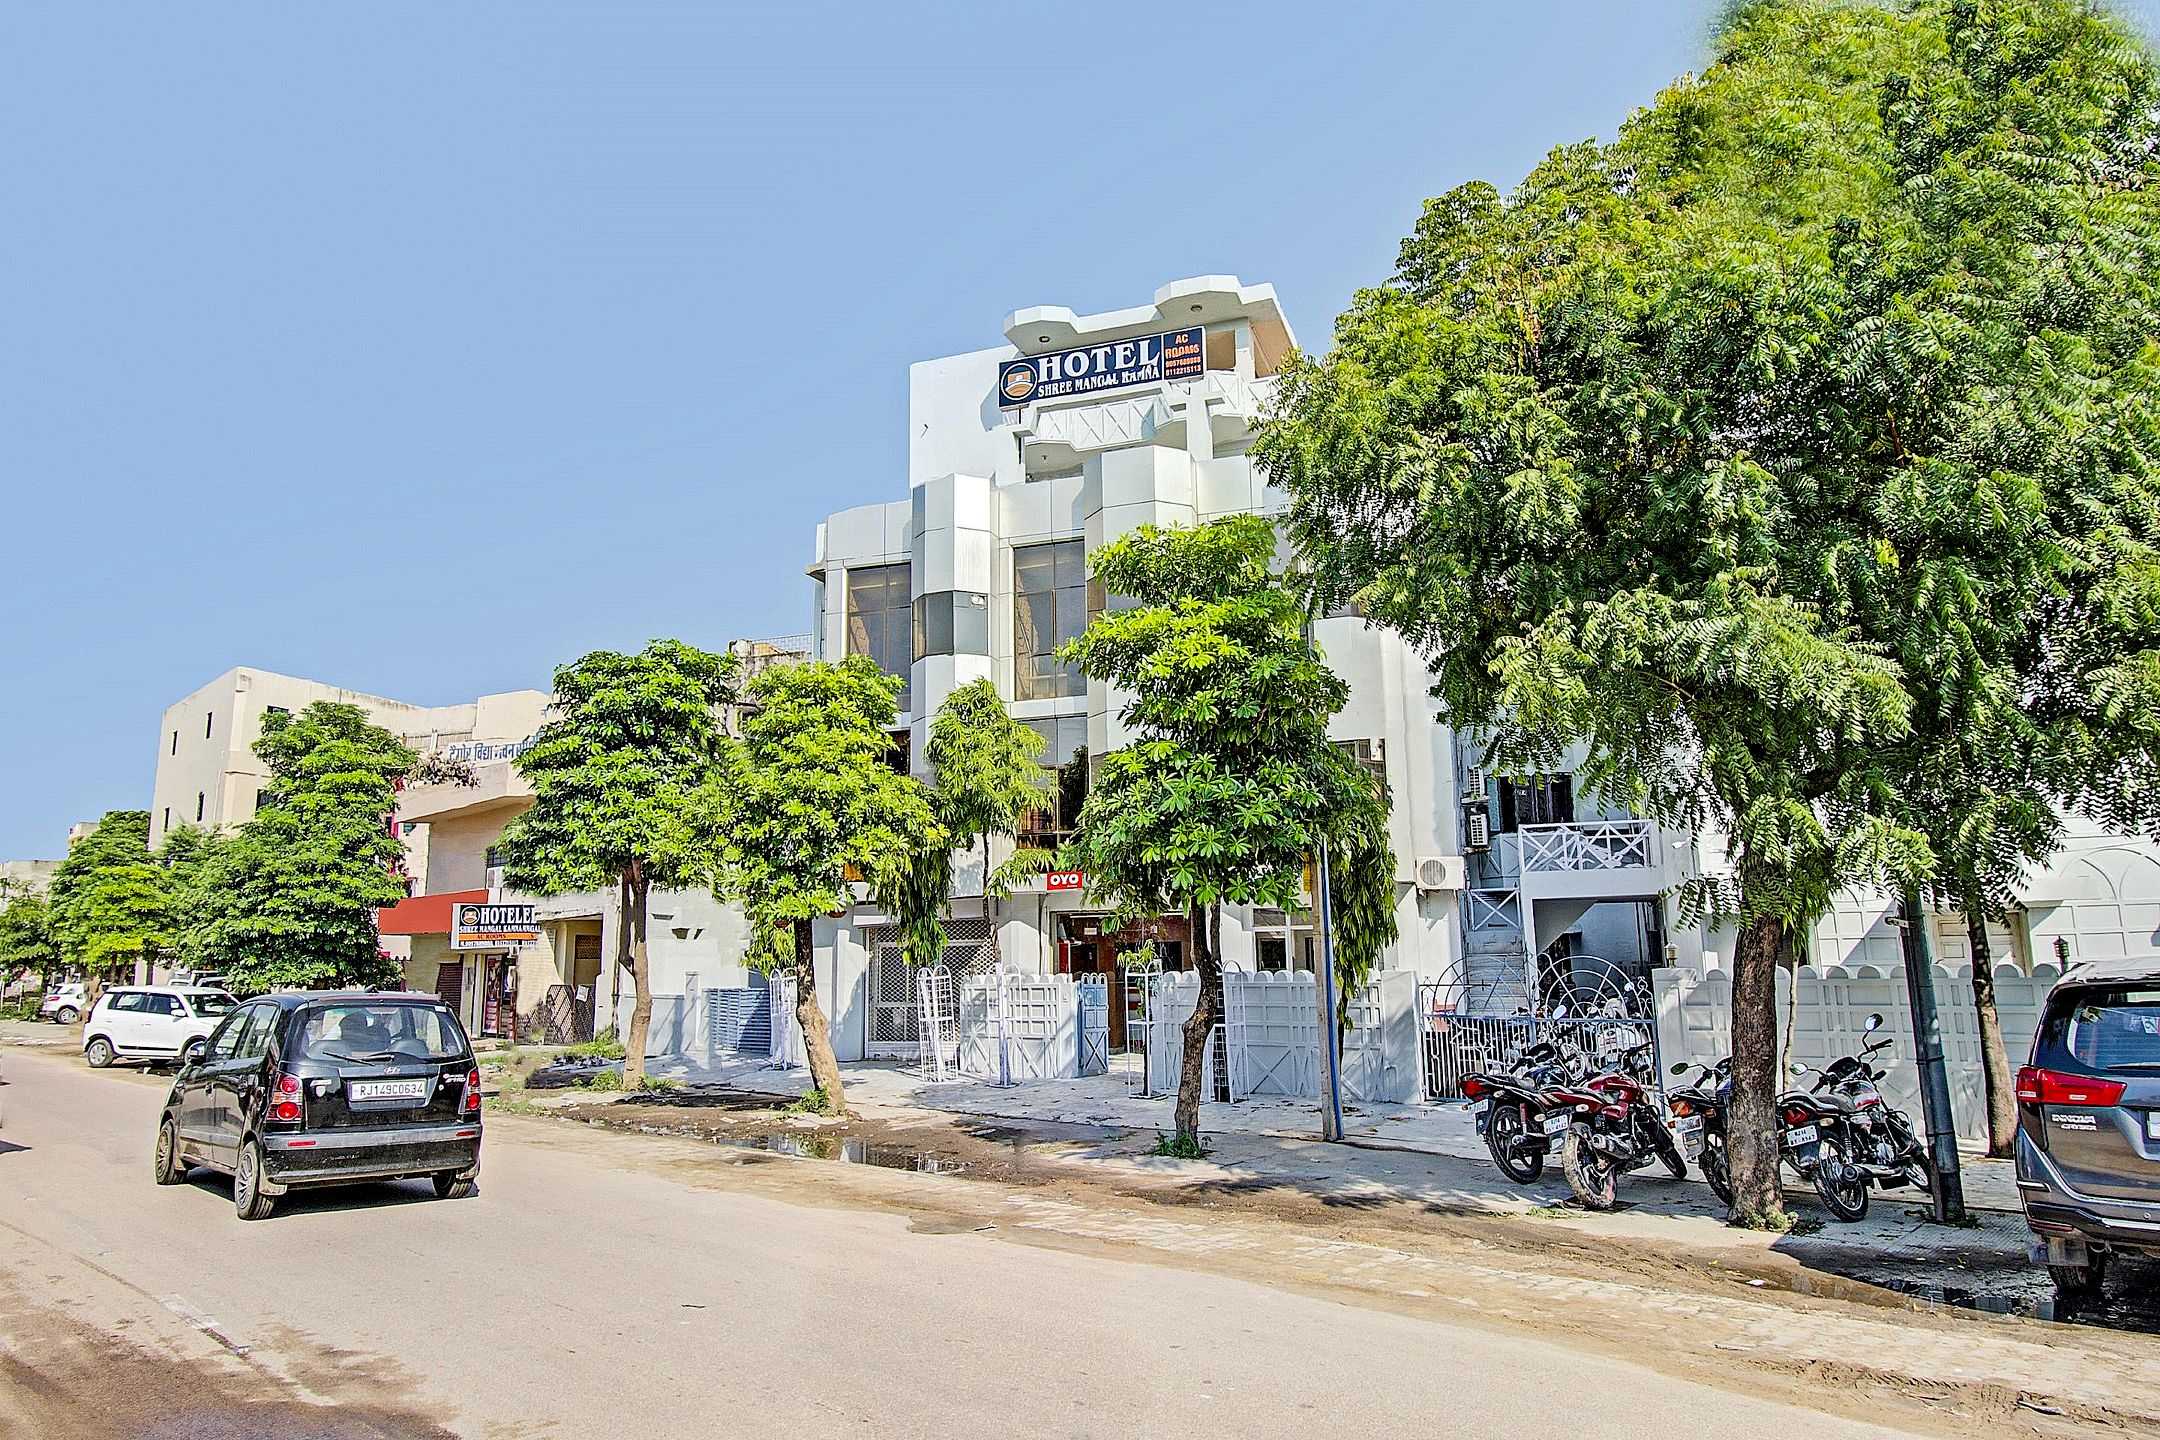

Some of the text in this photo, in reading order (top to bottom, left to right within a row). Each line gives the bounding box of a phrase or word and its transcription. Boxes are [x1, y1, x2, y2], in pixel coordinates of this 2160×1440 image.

[1175, 334, 1188, 344] AC
[1038, 339, 1160, 383] HOTEL
[1038, 381, 1073, 397] SHREE
[1075, 373, 1119, 391] MANGAL
[1050, 873, 1079, 886] OYO
